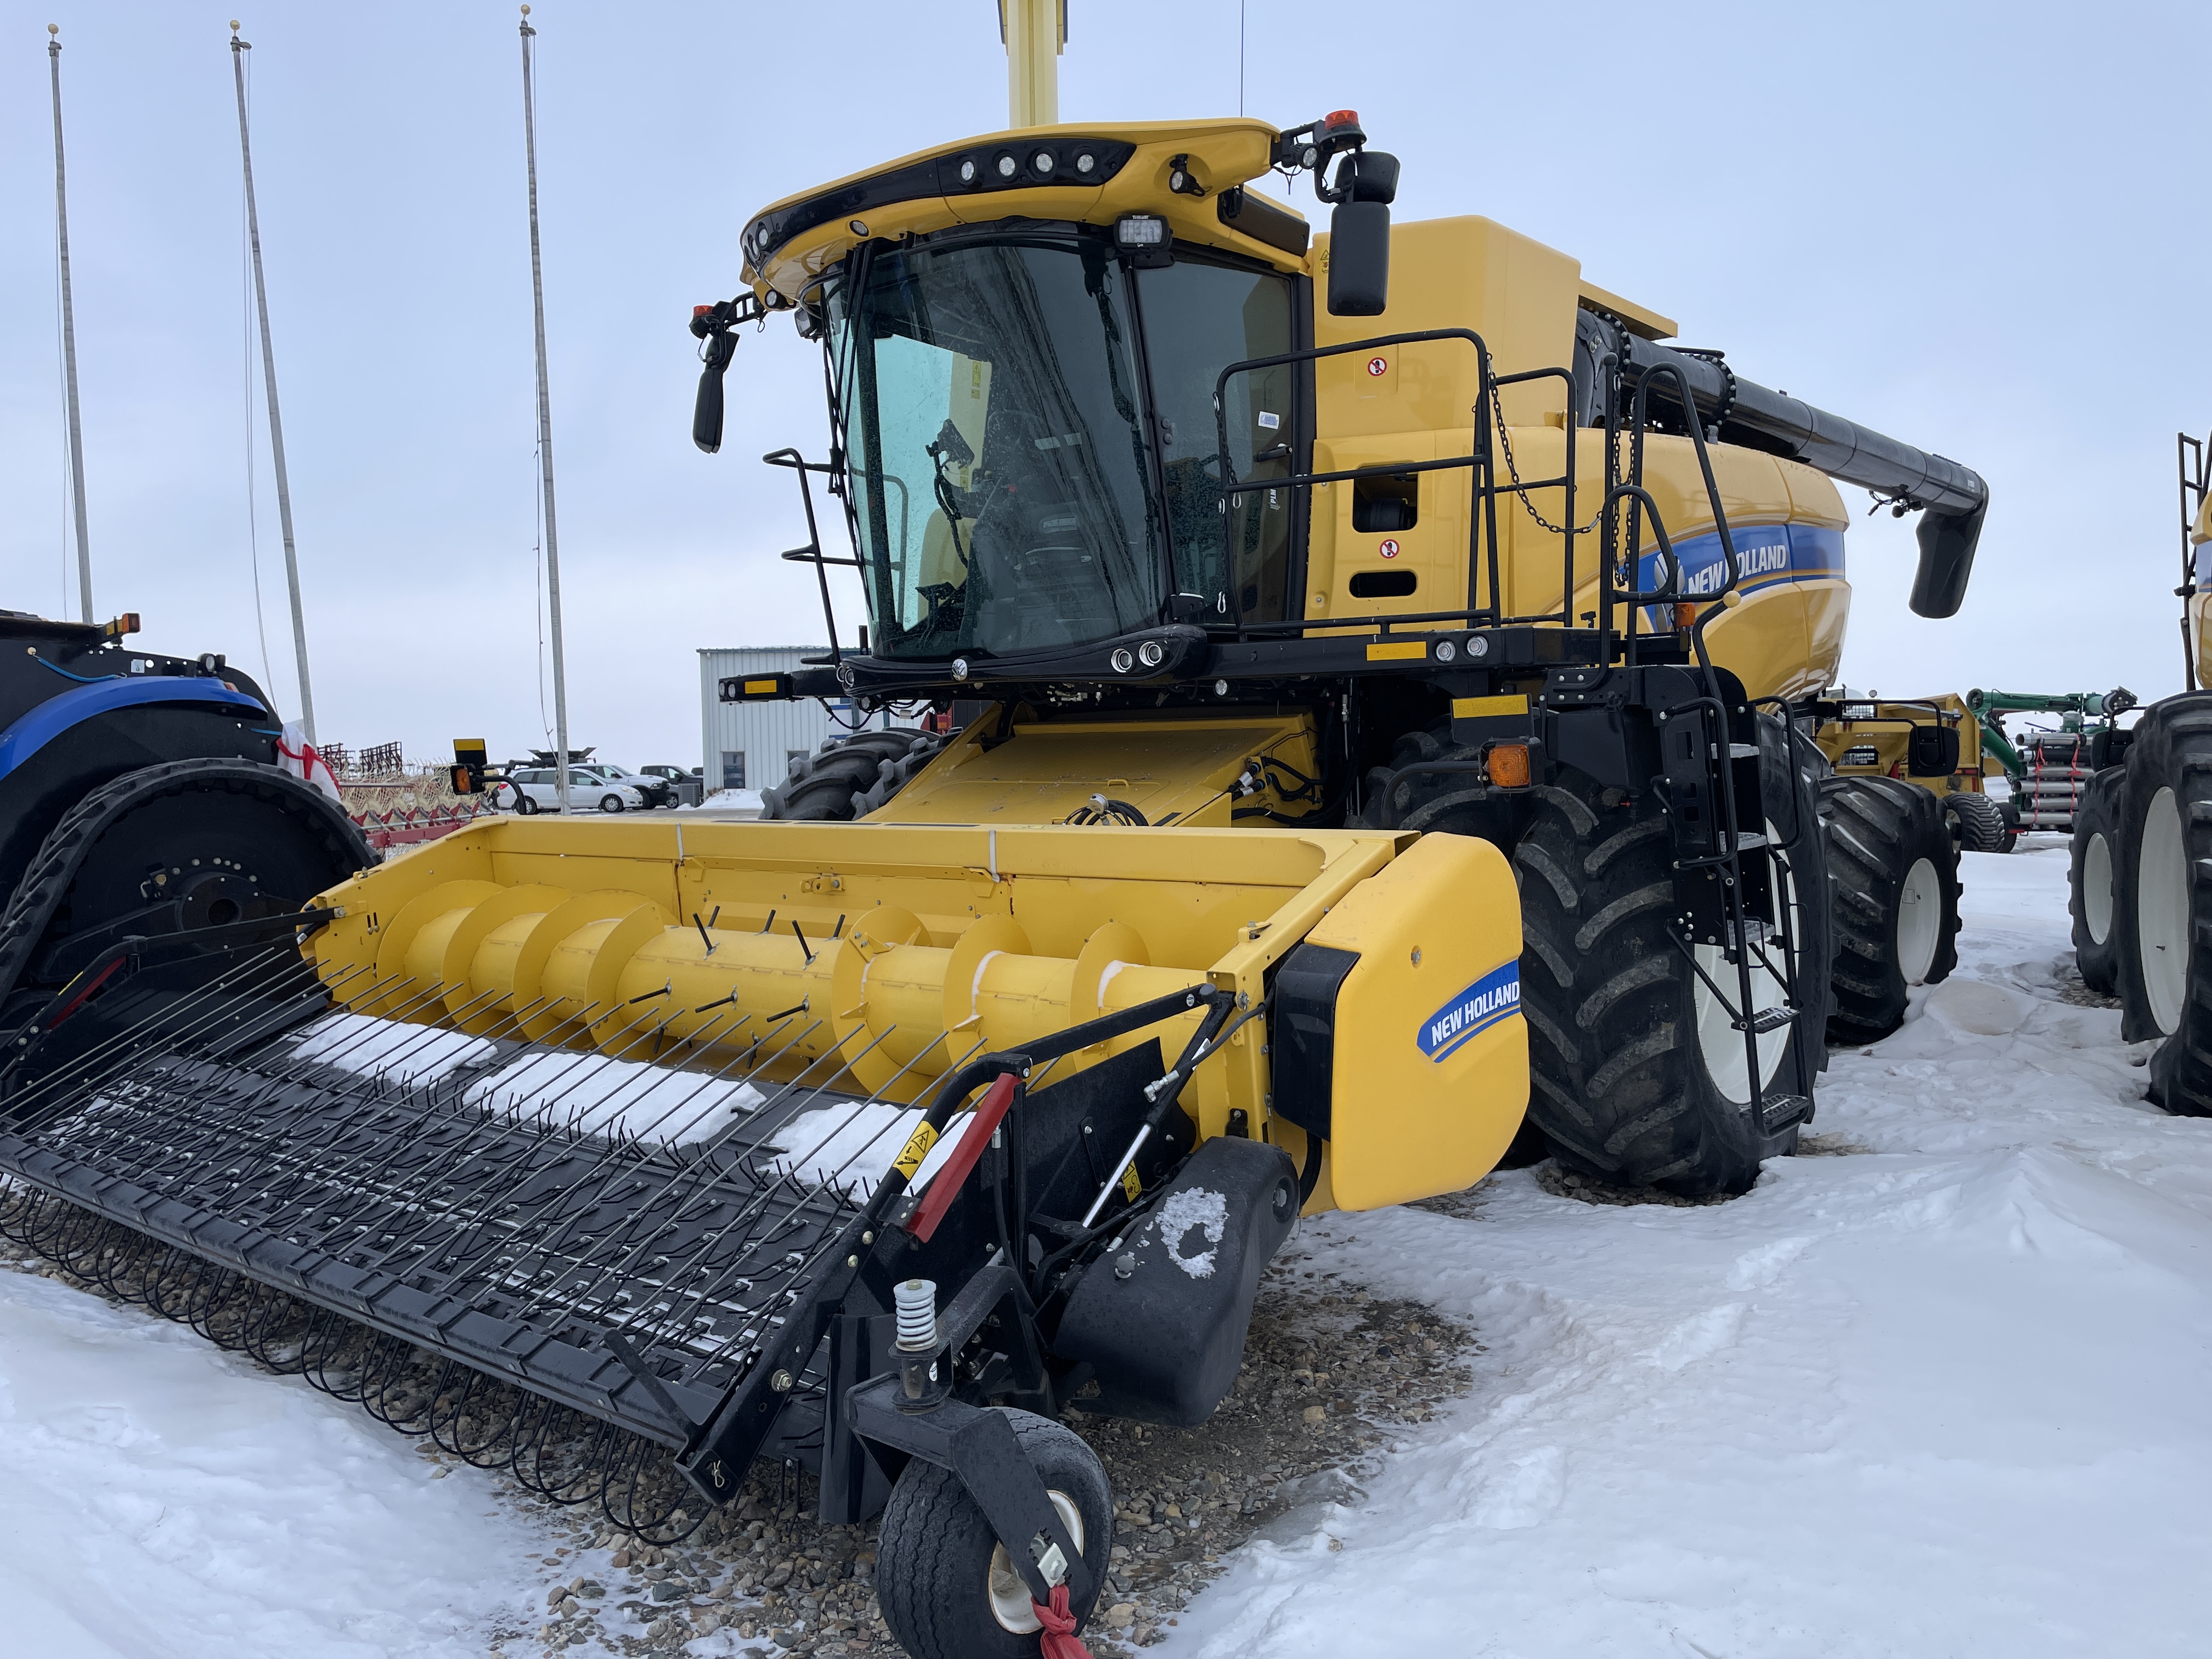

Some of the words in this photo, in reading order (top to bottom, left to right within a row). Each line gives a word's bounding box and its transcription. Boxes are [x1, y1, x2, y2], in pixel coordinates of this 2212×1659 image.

[1688, 561, 1723, 594] NEW
[1431, 1007, 1463, 1047] NEW
[1465, 981, 1520, 1025] HOLLAND
